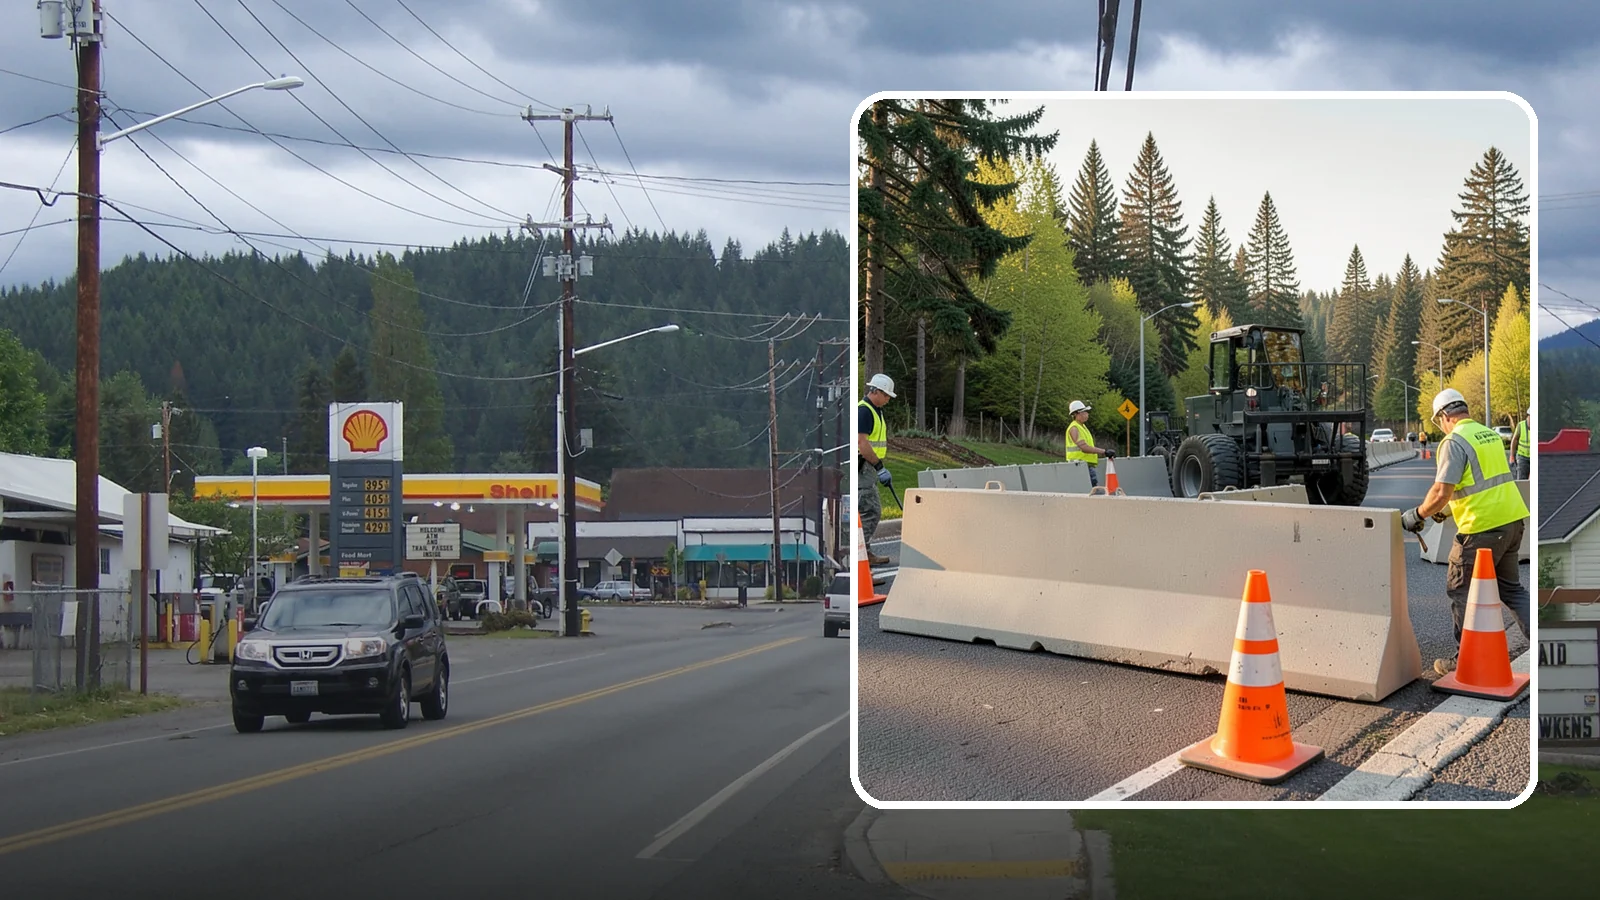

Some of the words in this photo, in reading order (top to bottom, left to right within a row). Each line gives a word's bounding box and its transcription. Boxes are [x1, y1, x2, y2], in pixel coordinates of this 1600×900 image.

[366, 480, 384, 490] 395
[490, 484, 547, 499] Shell
[366, 494, 384, 504] 405
[366, 508, 384, 518] 415
[366, 522, 384, 533] 429
